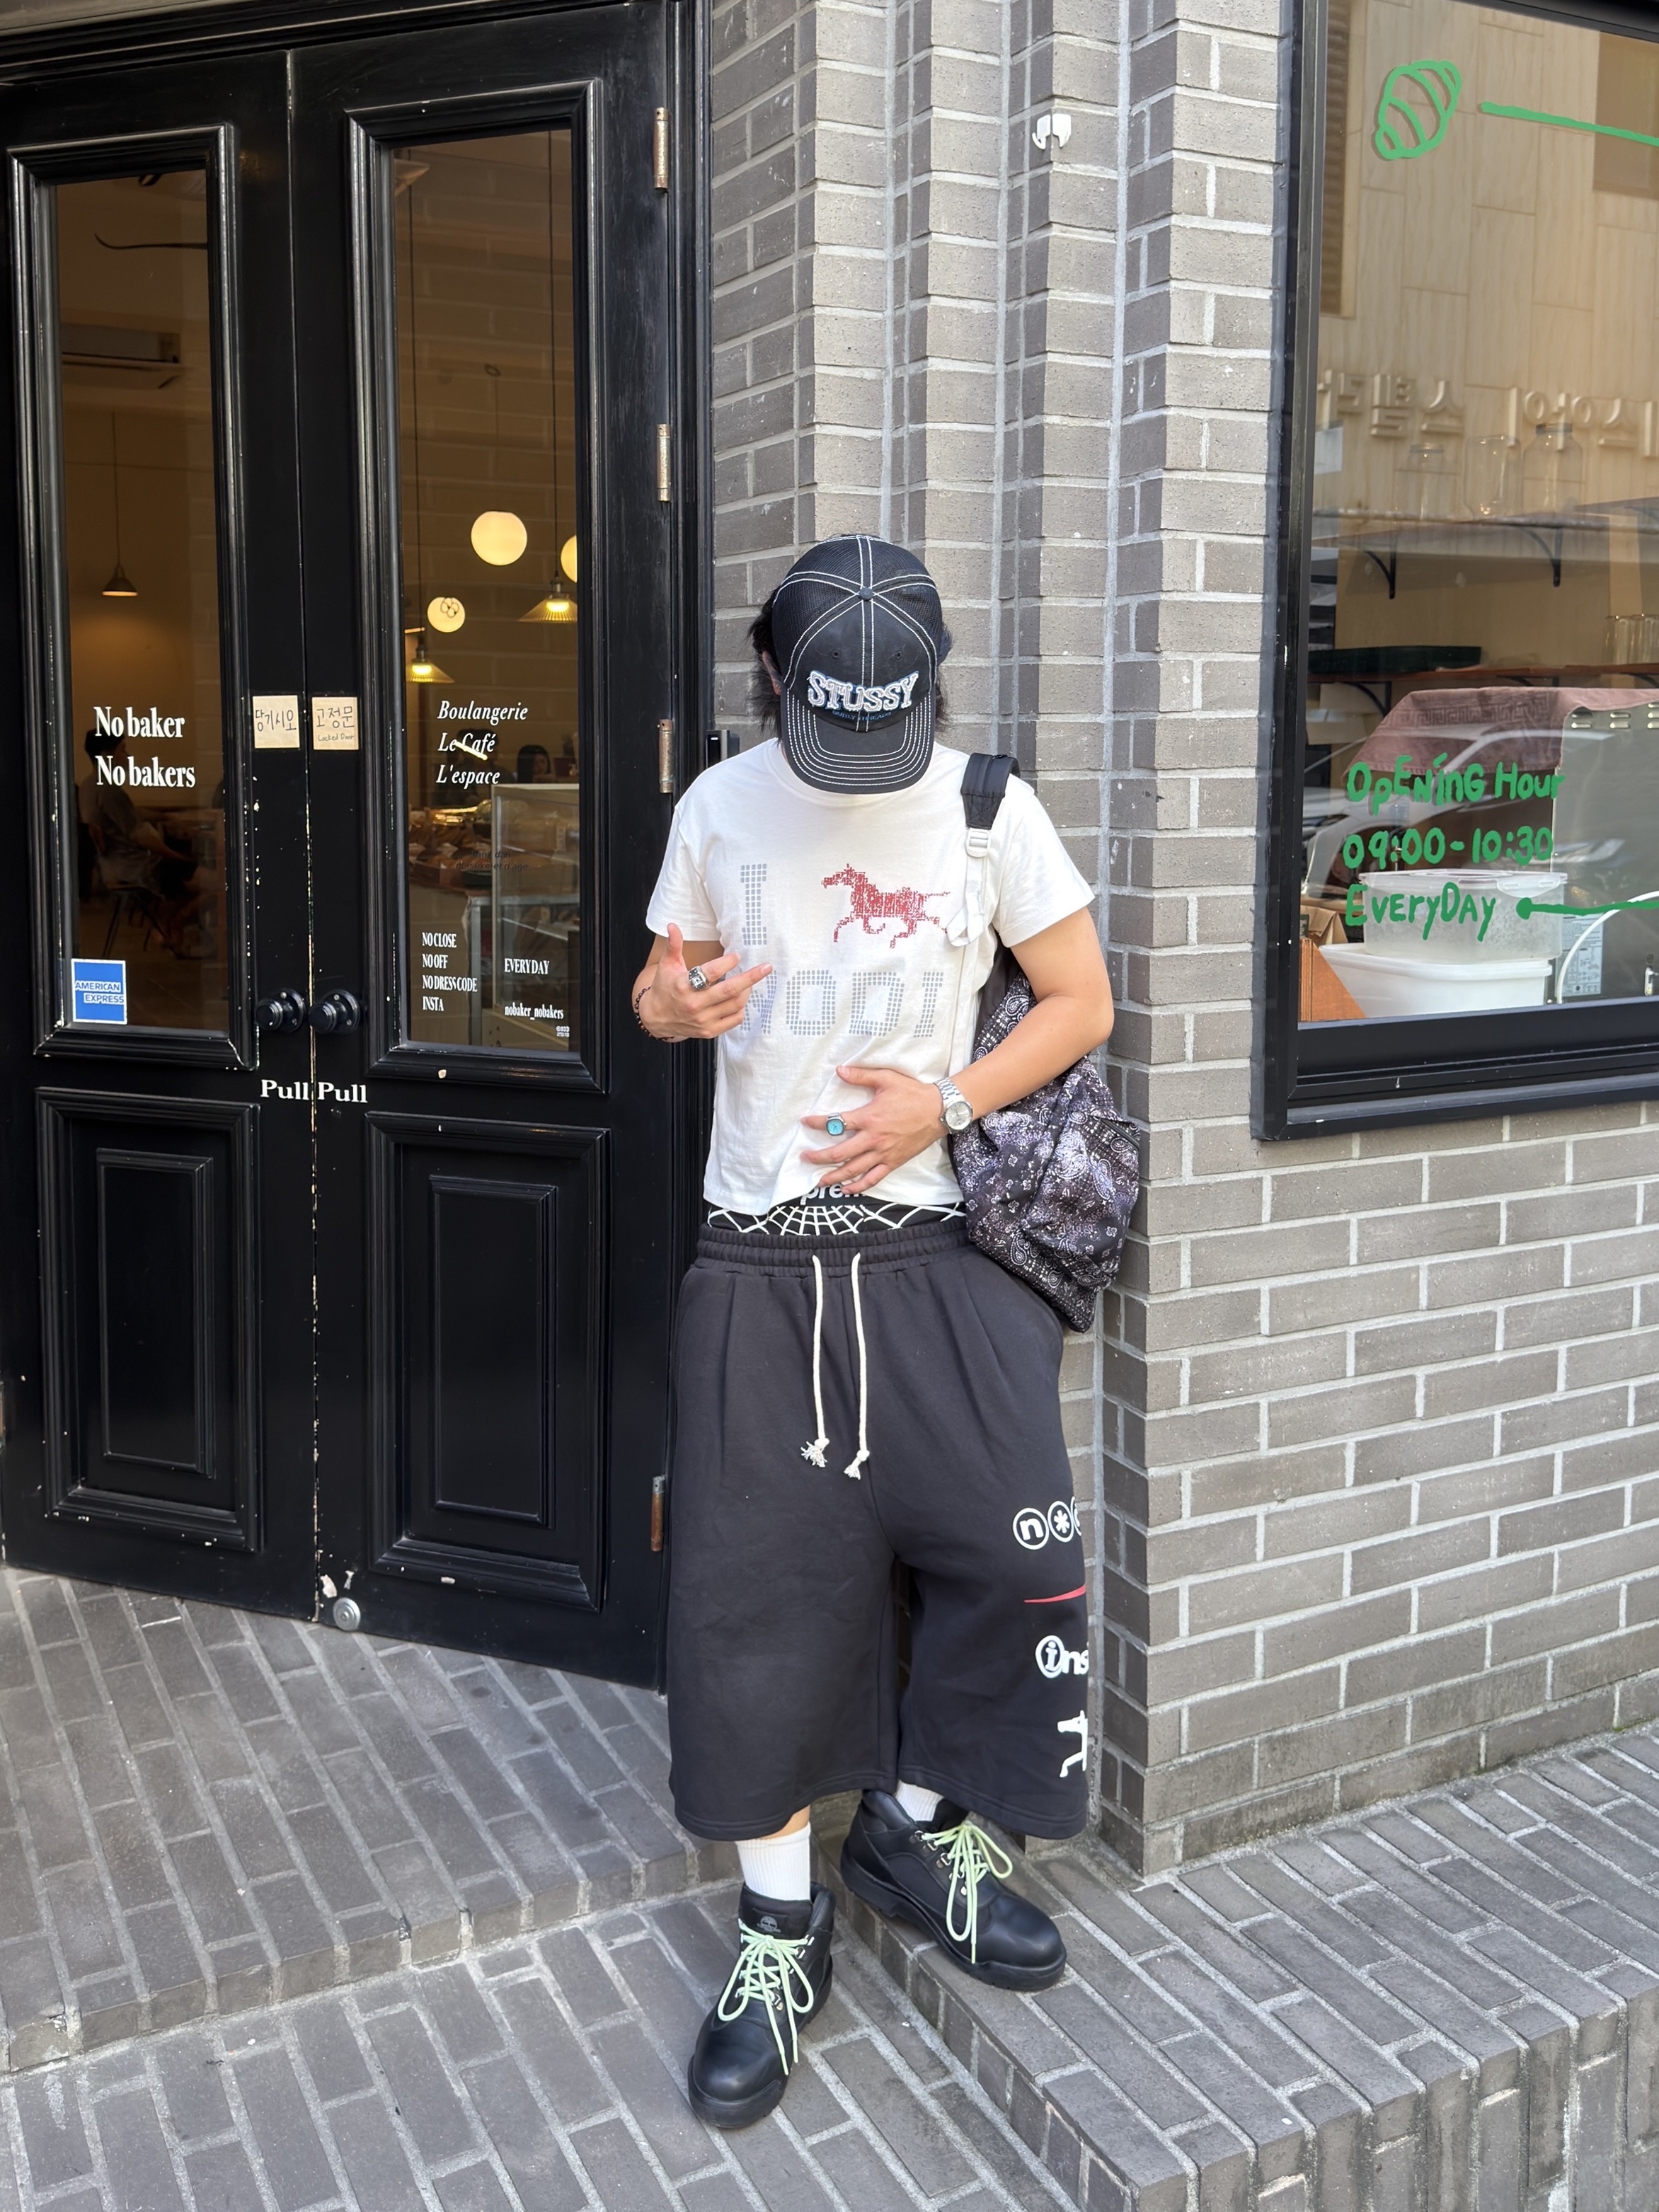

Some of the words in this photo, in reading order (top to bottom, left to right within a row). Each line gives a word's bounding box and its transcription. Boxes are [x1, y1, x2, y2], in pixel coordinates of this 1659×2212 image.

[807, 671, 919, 712] STUSSY
[93, 706, 124, 737] No
[126, 707, 185, 738] baker
[255, 709, 297, 732] 당기시오
[316, 706, 355, 729] 고정문
[437, 701, 528, 726] Boulangerie
[318, 733, 338, 742] Locked
[437, 732, 457, 751] Le
[462, 732, 496, 755] Café
[96, 756, 125, 786] No
[128, 756, 195, 788] bakers
[436, 764, 500, 790] L'espace
[1494, 761, 1566, 800] Hour
[422, 932, 433, 947] NO
[433, 933, 457, 948] CLOSE
[422, 953, 433, 968] NO
[434, 954, 448, 969] OFF
[75, 981, 120, 991] AMERICAN
[423, 975, 434, 989] NO
[434, 976, 457, 991] DRESS
[457, 977, 478, 992] CODE
[85, 993, 124, 1003] EXPRESS
[423, 996, 444, 1011] INSTA
[505, 1002, 564, 1020] nobaker_nobakers
[260, 1079, 309, 1101] Pull
[317, 1082, 368, 1104] Pull
